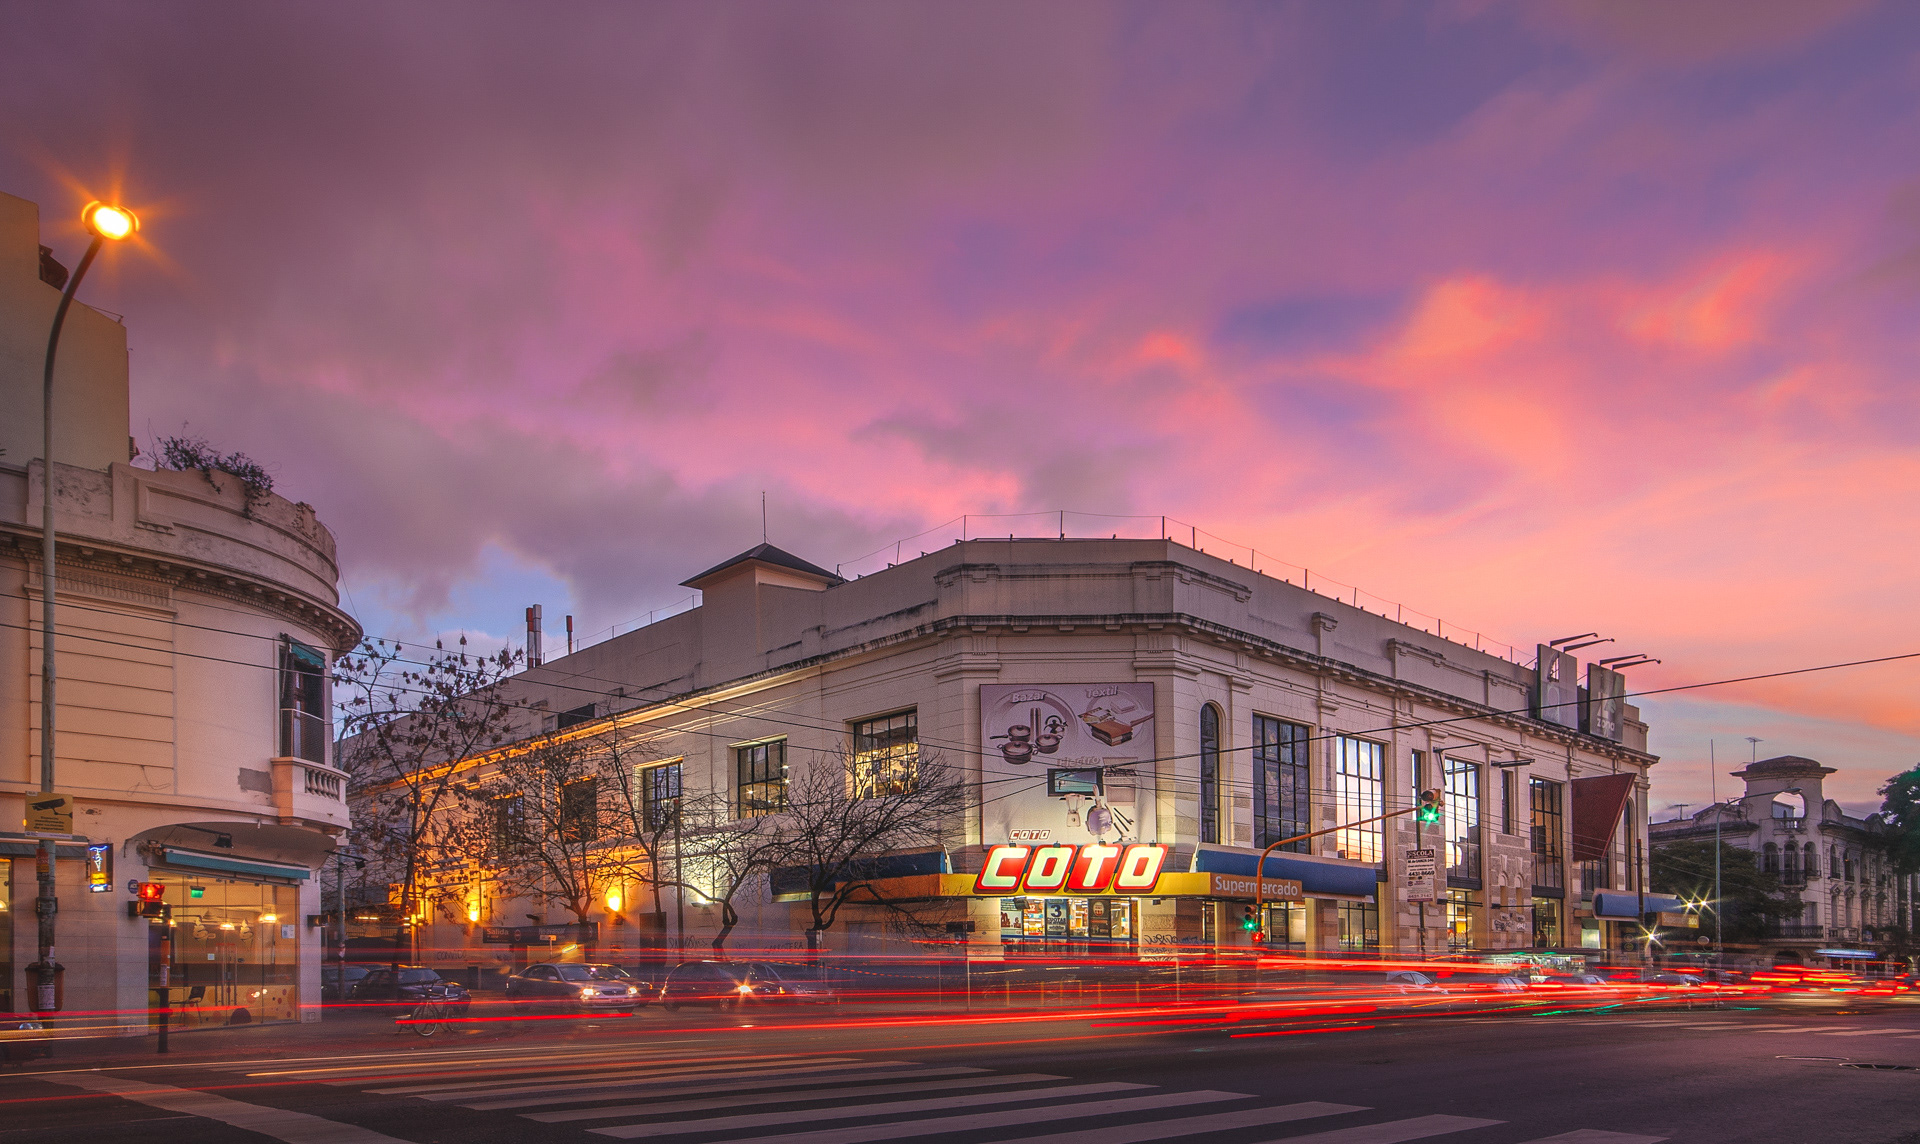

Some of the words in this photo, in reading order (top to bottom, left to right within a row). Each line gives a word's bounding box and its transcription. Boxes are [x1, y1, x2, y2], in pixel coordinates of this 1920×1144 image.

[1011, 692, 1047, 703] Bazar
[1086, 686, 1118, 698] Textil
[1056, 756, 1102, 767] Electro
[1009, 829, 1051, 841] COTO
[979, 845, 1167, 889] COTO
[1215, 876, 1298, 896] Supermercado
[1050, 904, 1062, 917] 3
